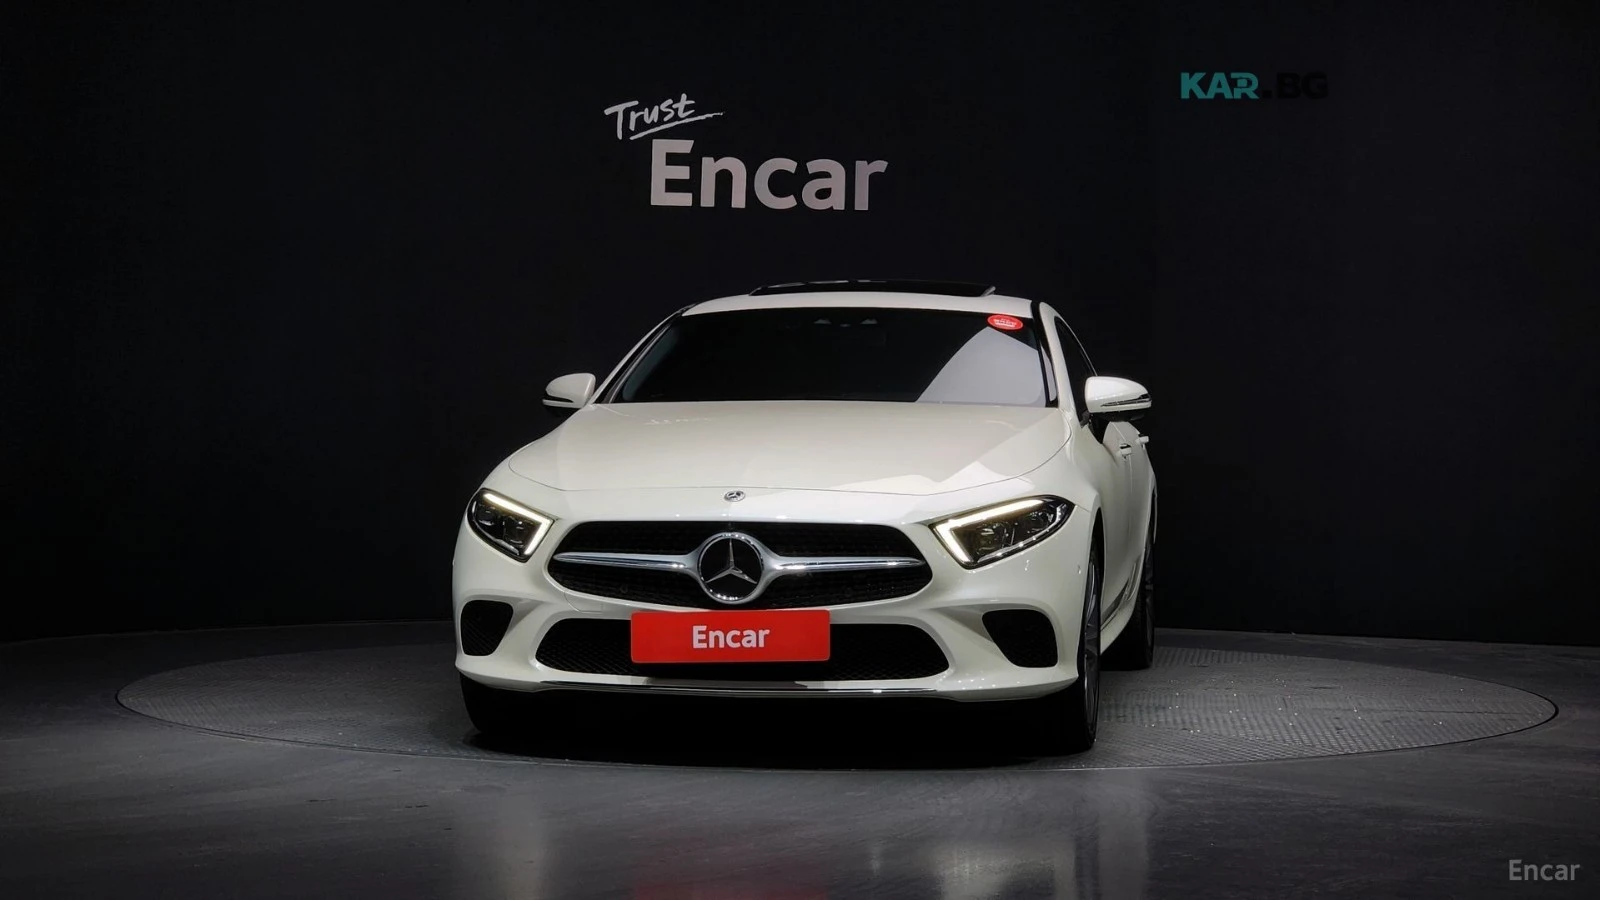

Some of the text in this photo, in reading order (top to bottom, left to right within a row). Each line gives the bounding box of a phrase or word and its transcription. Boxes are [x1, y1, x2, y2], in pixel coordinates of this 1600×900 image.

[603, 93, 695, 140] Trust
[650, 139, 889, 211] Encar
[692, 625, 771, 649] Encar
